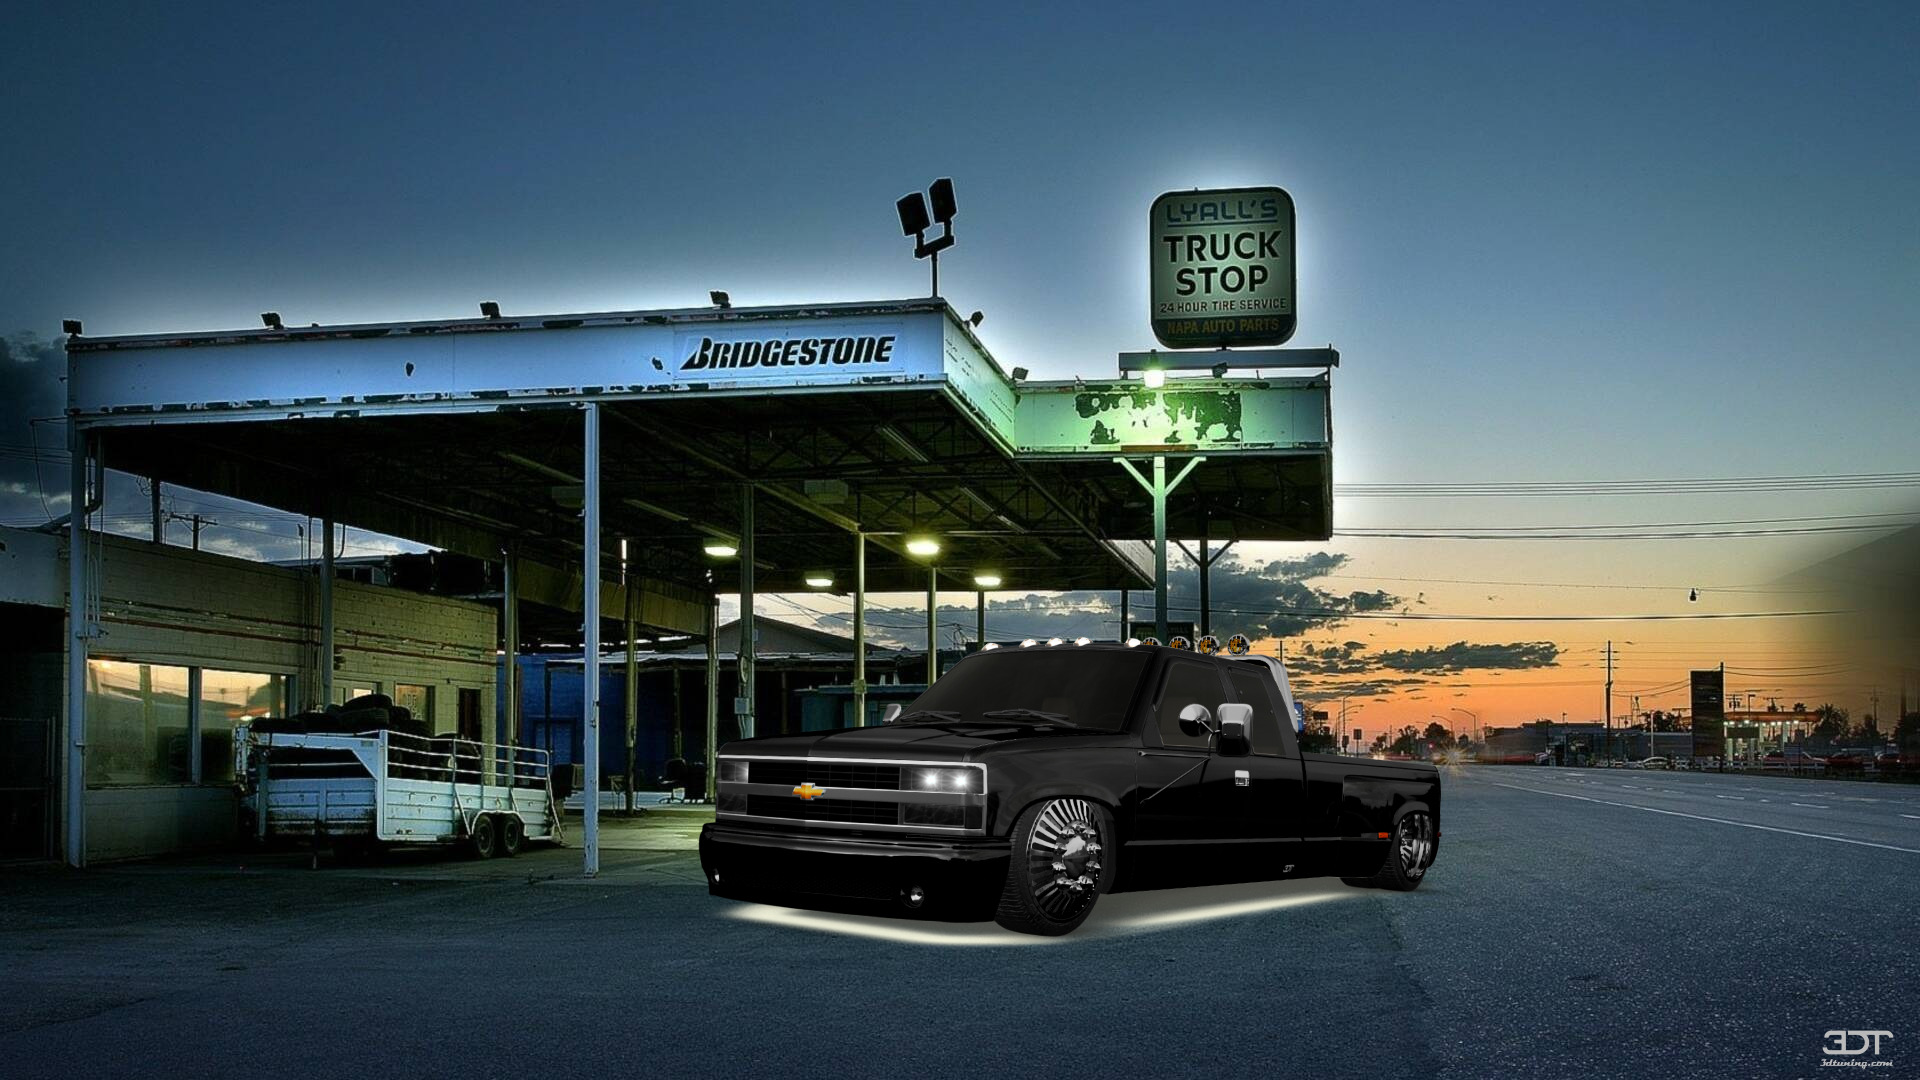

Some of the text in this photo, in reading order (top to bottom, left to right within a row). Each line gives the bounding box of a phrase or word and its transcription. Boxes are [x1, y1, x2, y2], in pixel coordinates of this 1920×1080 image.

[1167, 199, 1278, 222] LYALL'S
[1163, 230, 1282, 262] TRUCK
[1175, 264, 1268, 296] STOP
[1160, 298, 1287, 313] 24 HOUR TIRE SERVICE
[1167, 318, 1280, 334] NAPA AUTO PARTS
[680, 336, 896, 370] BRIDGESTONE
